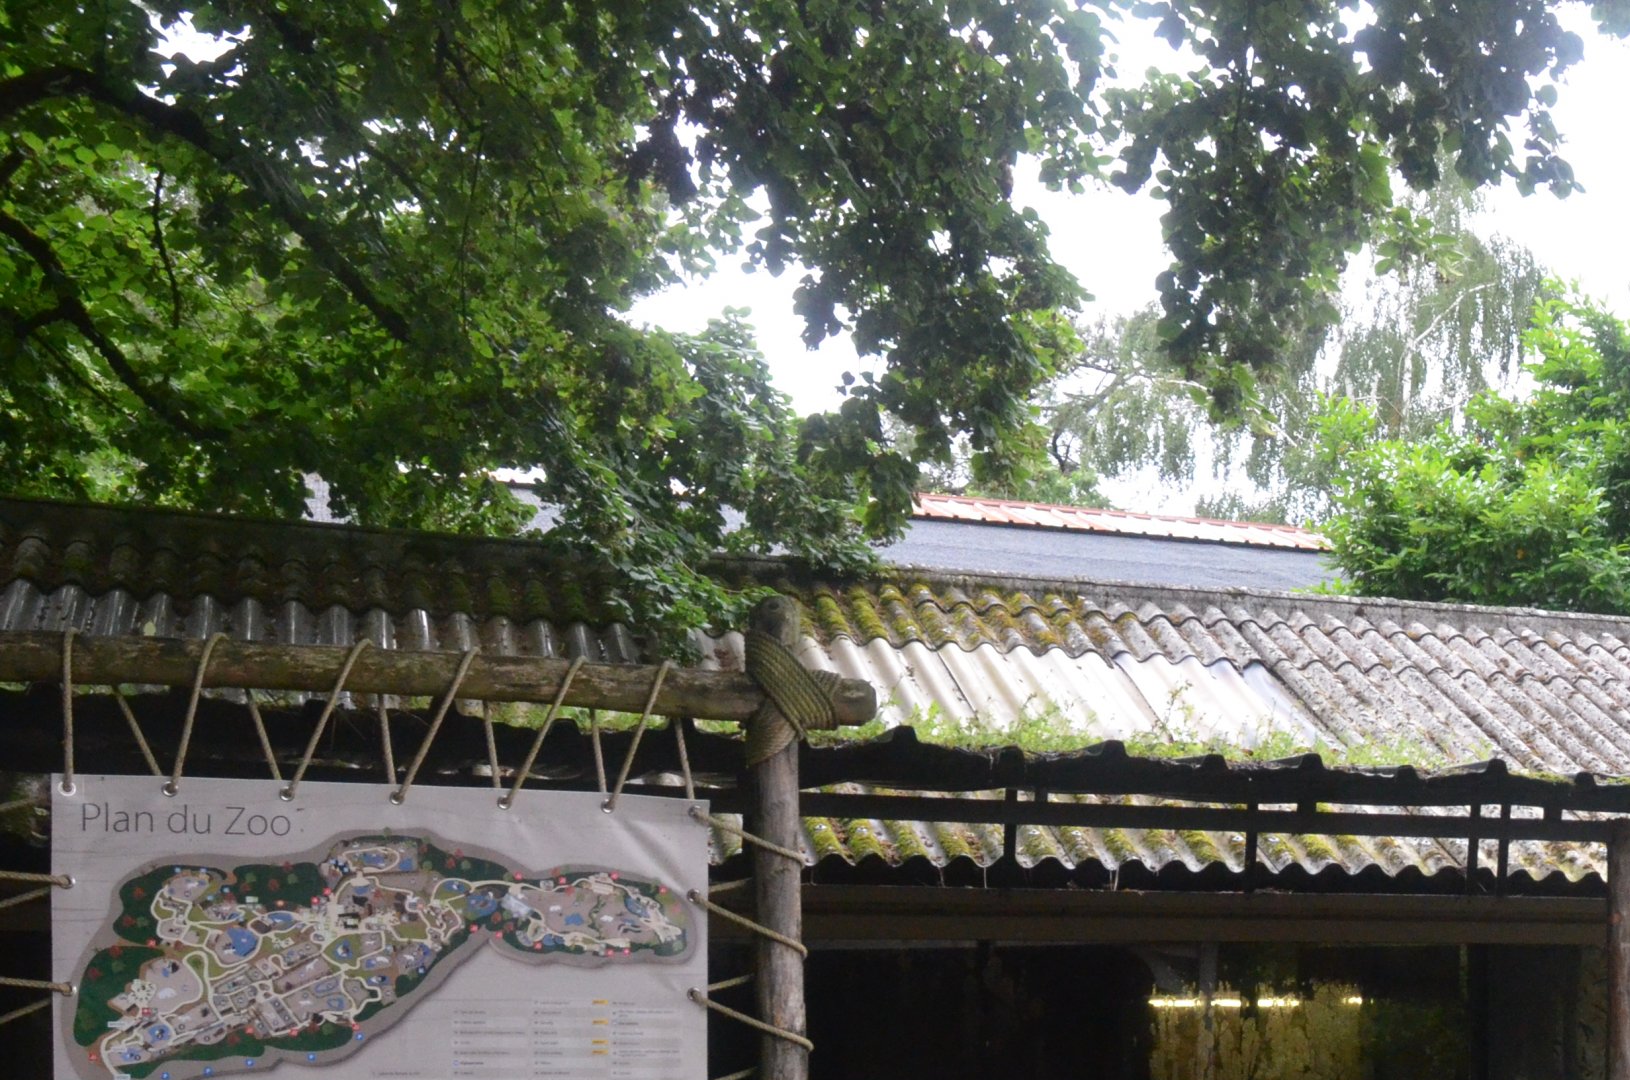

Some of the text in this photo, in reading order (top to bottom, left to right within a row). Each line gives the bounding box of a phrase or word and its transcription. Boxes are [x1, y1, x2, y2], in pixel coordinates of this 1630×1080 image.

[81, 802, 291, 836] Plan du Zoo
